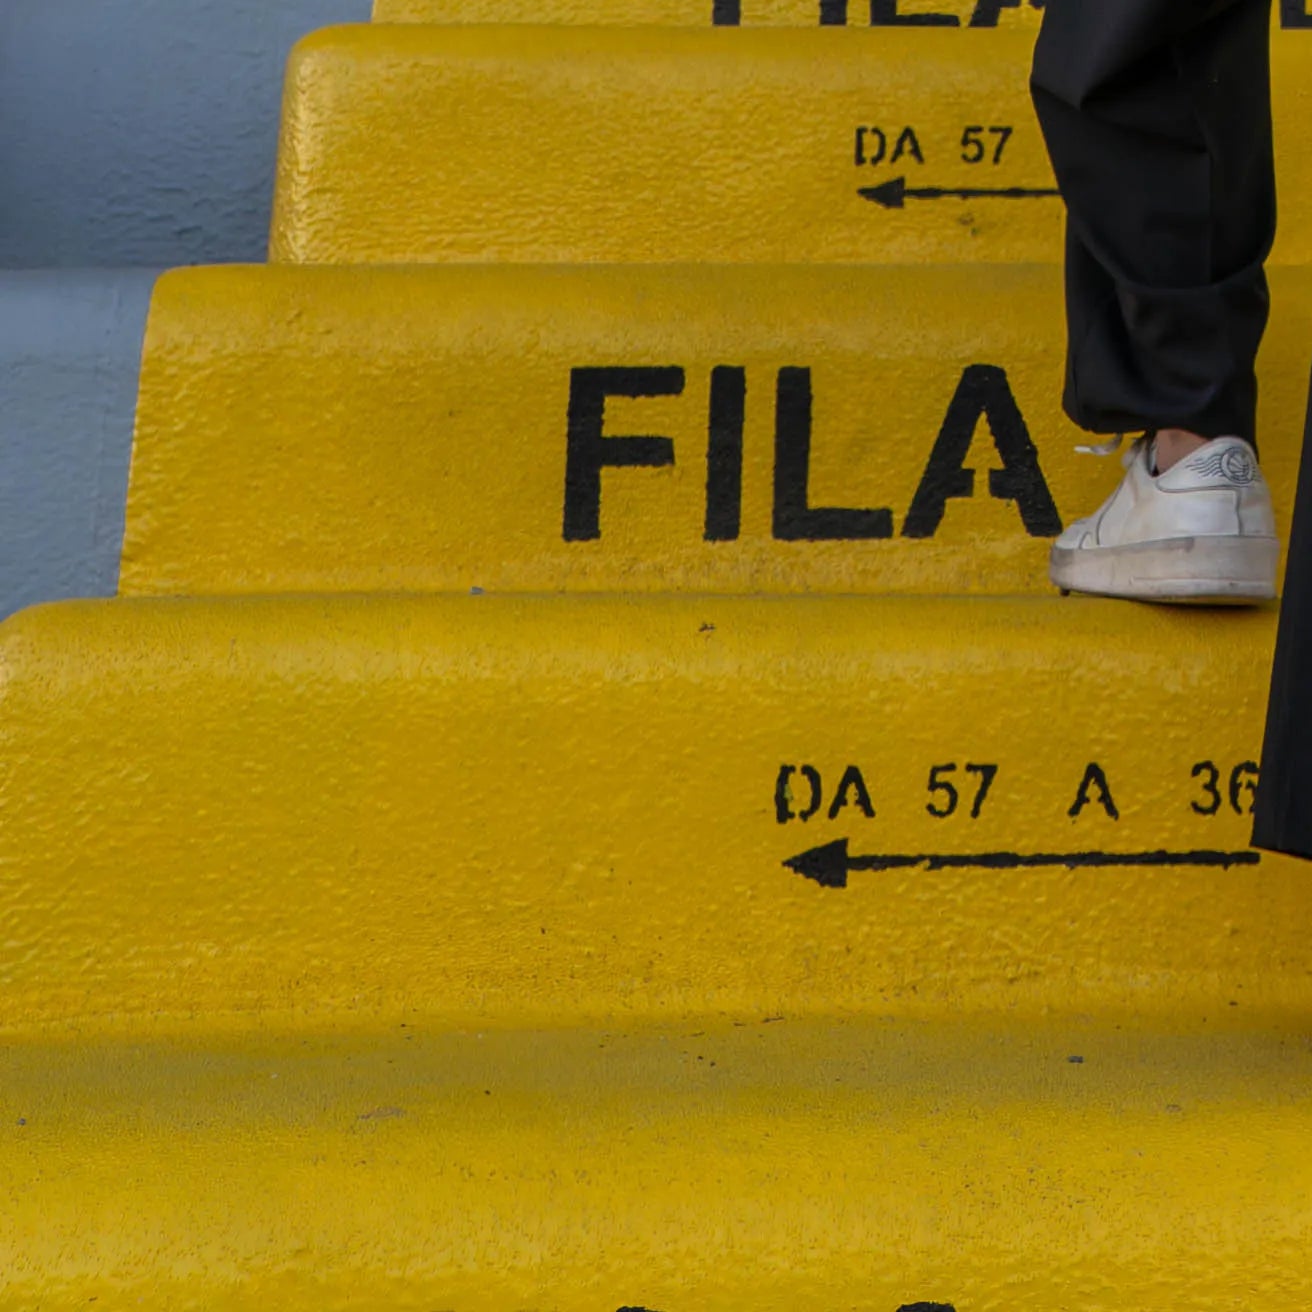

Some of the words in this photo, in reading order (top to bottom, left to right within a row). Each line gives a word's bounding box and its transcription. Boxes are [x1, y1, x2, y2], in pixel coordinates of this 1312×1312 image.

[853, 126, 925, 166] DA
[960, 126, 1013, 164] 57
[562, 364, 1063, 541] FILA
[774, 764, 876, 824] DA
[926, 763, 998, 819] 57
[1067, 762, 1119, 820] A
